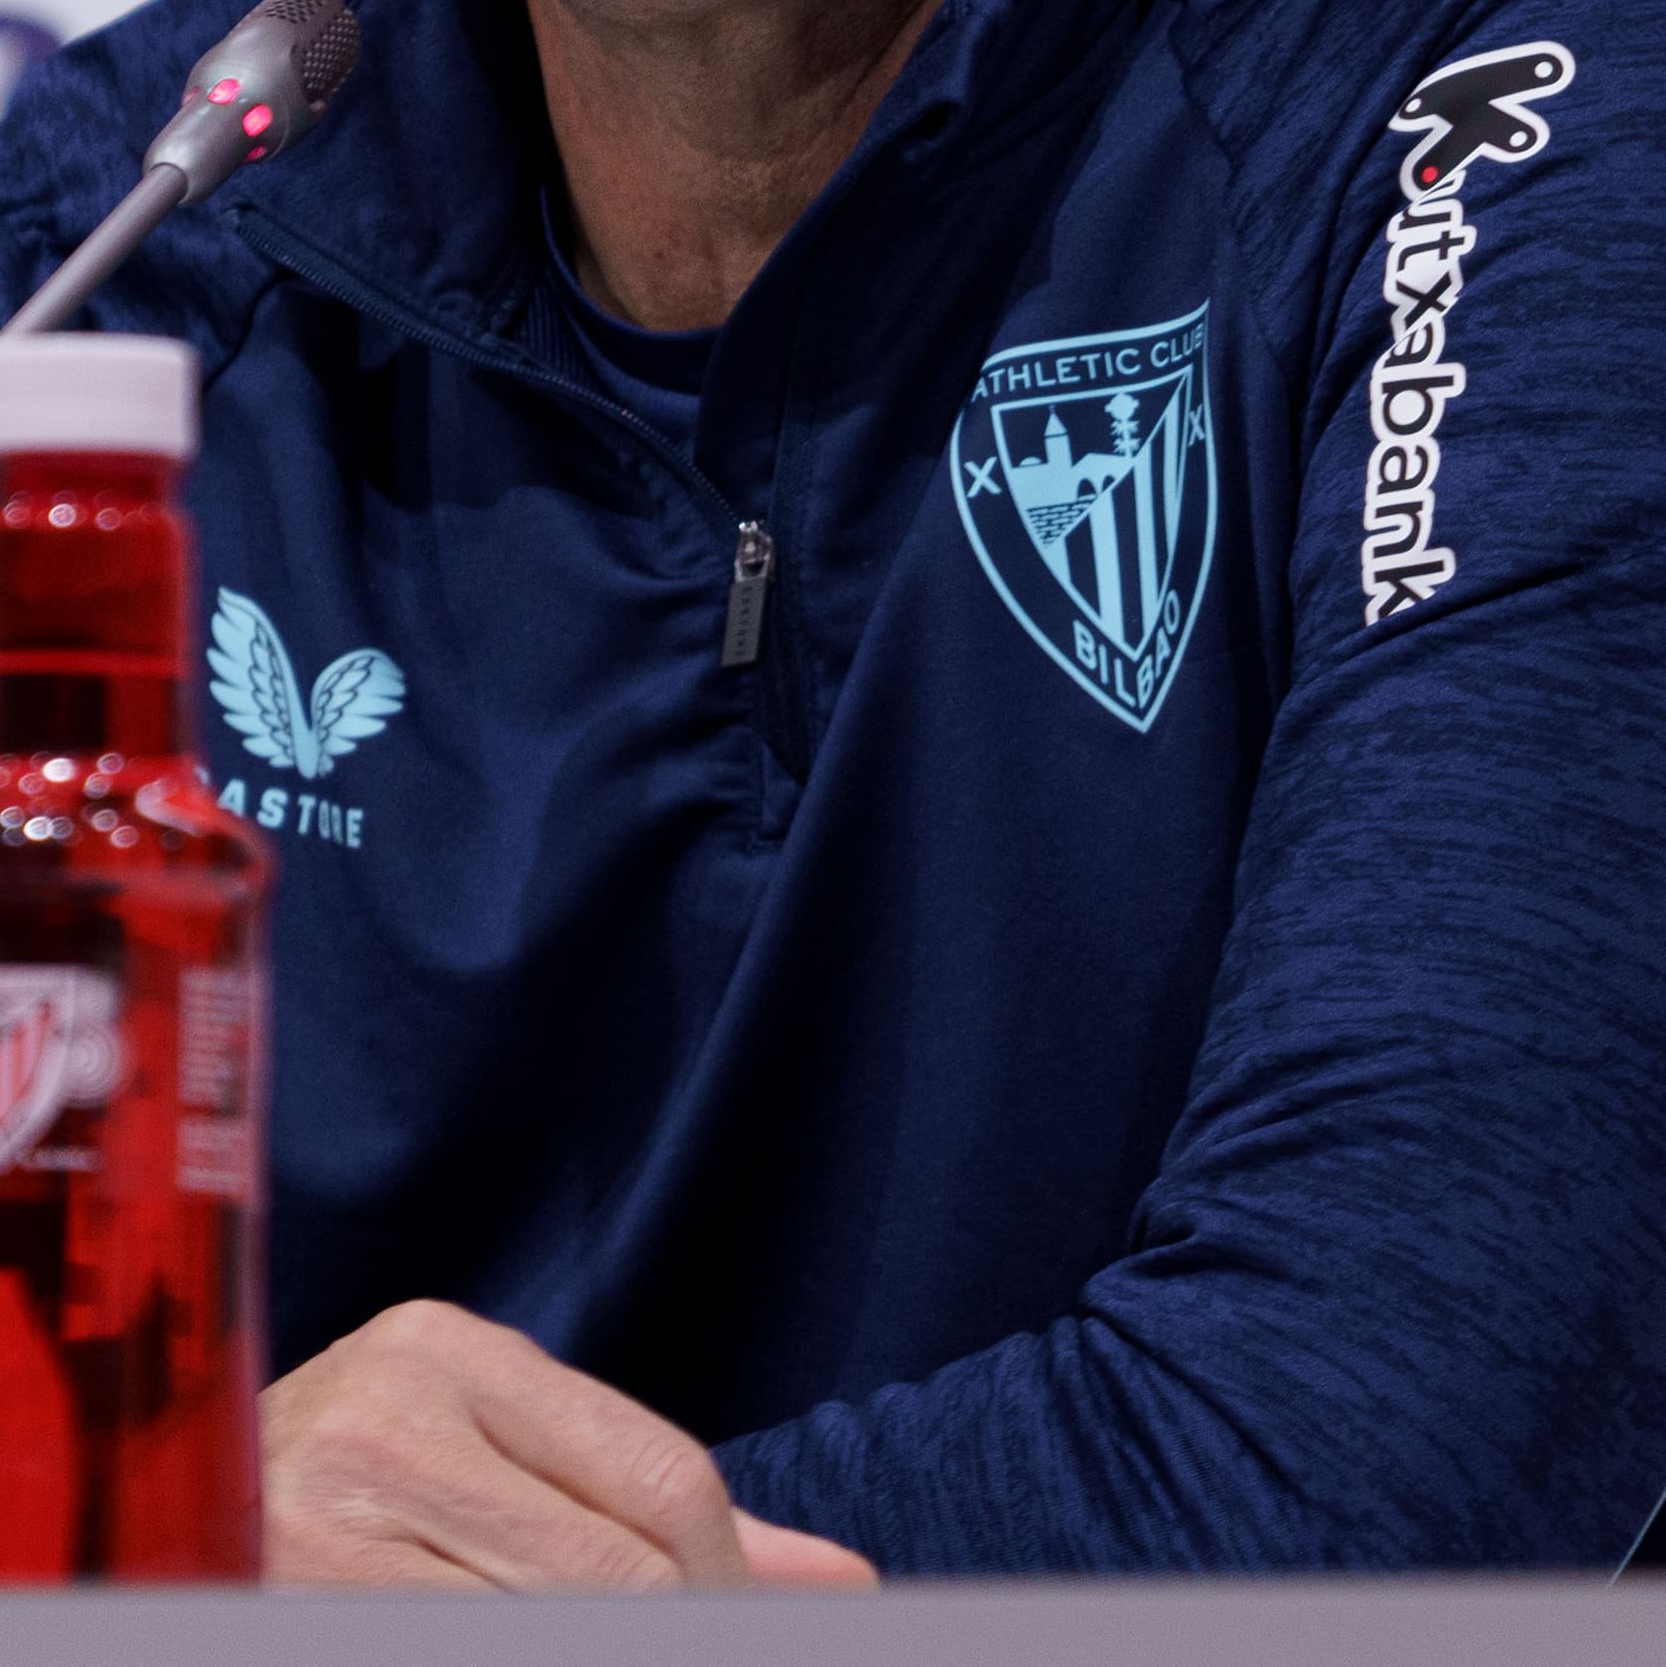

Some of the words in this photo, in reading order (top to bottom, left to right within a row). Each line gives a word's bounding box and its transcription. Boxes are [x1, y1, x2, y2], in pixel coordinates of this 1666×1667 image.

[970, 346, 1142, 403] ATHLETIC
[1149, 322, 1206, 369] CLUB
[1072, 588, 1181, 711] BILBAO
[197, 766, 364, 850] ASTORE
